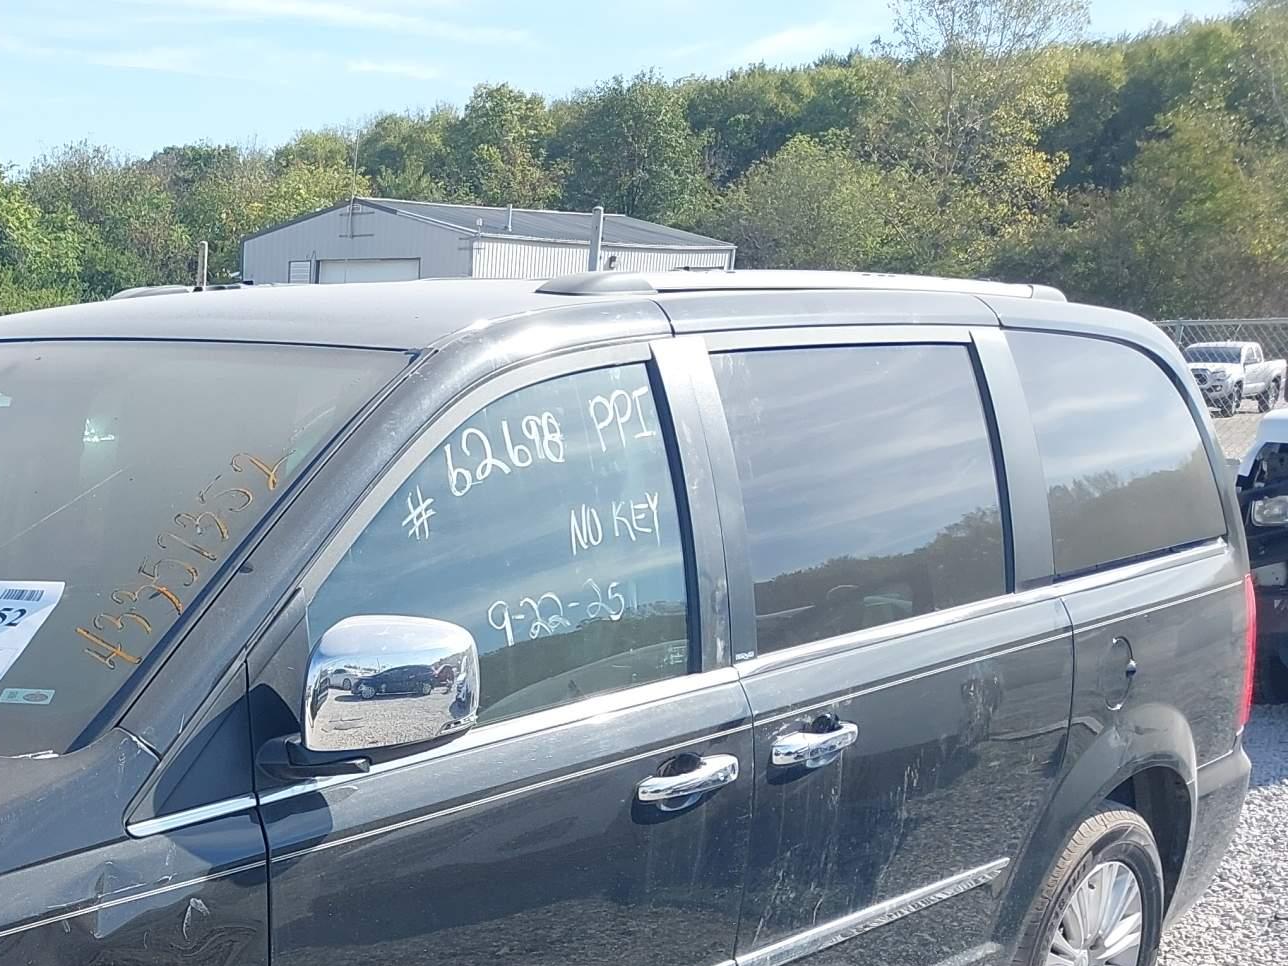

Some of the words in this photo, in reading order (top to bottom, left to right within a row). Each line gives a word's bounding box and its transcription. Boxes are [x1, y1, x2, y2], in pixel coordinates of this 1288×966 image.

[588, 386, 657, 453] PPI
[570, 503, 603, 556] NO
[612, 491, 661, 548] KEY
[75, 450, 296, 671] 43351352
[487, 577, 625, 647] 9-22-25
